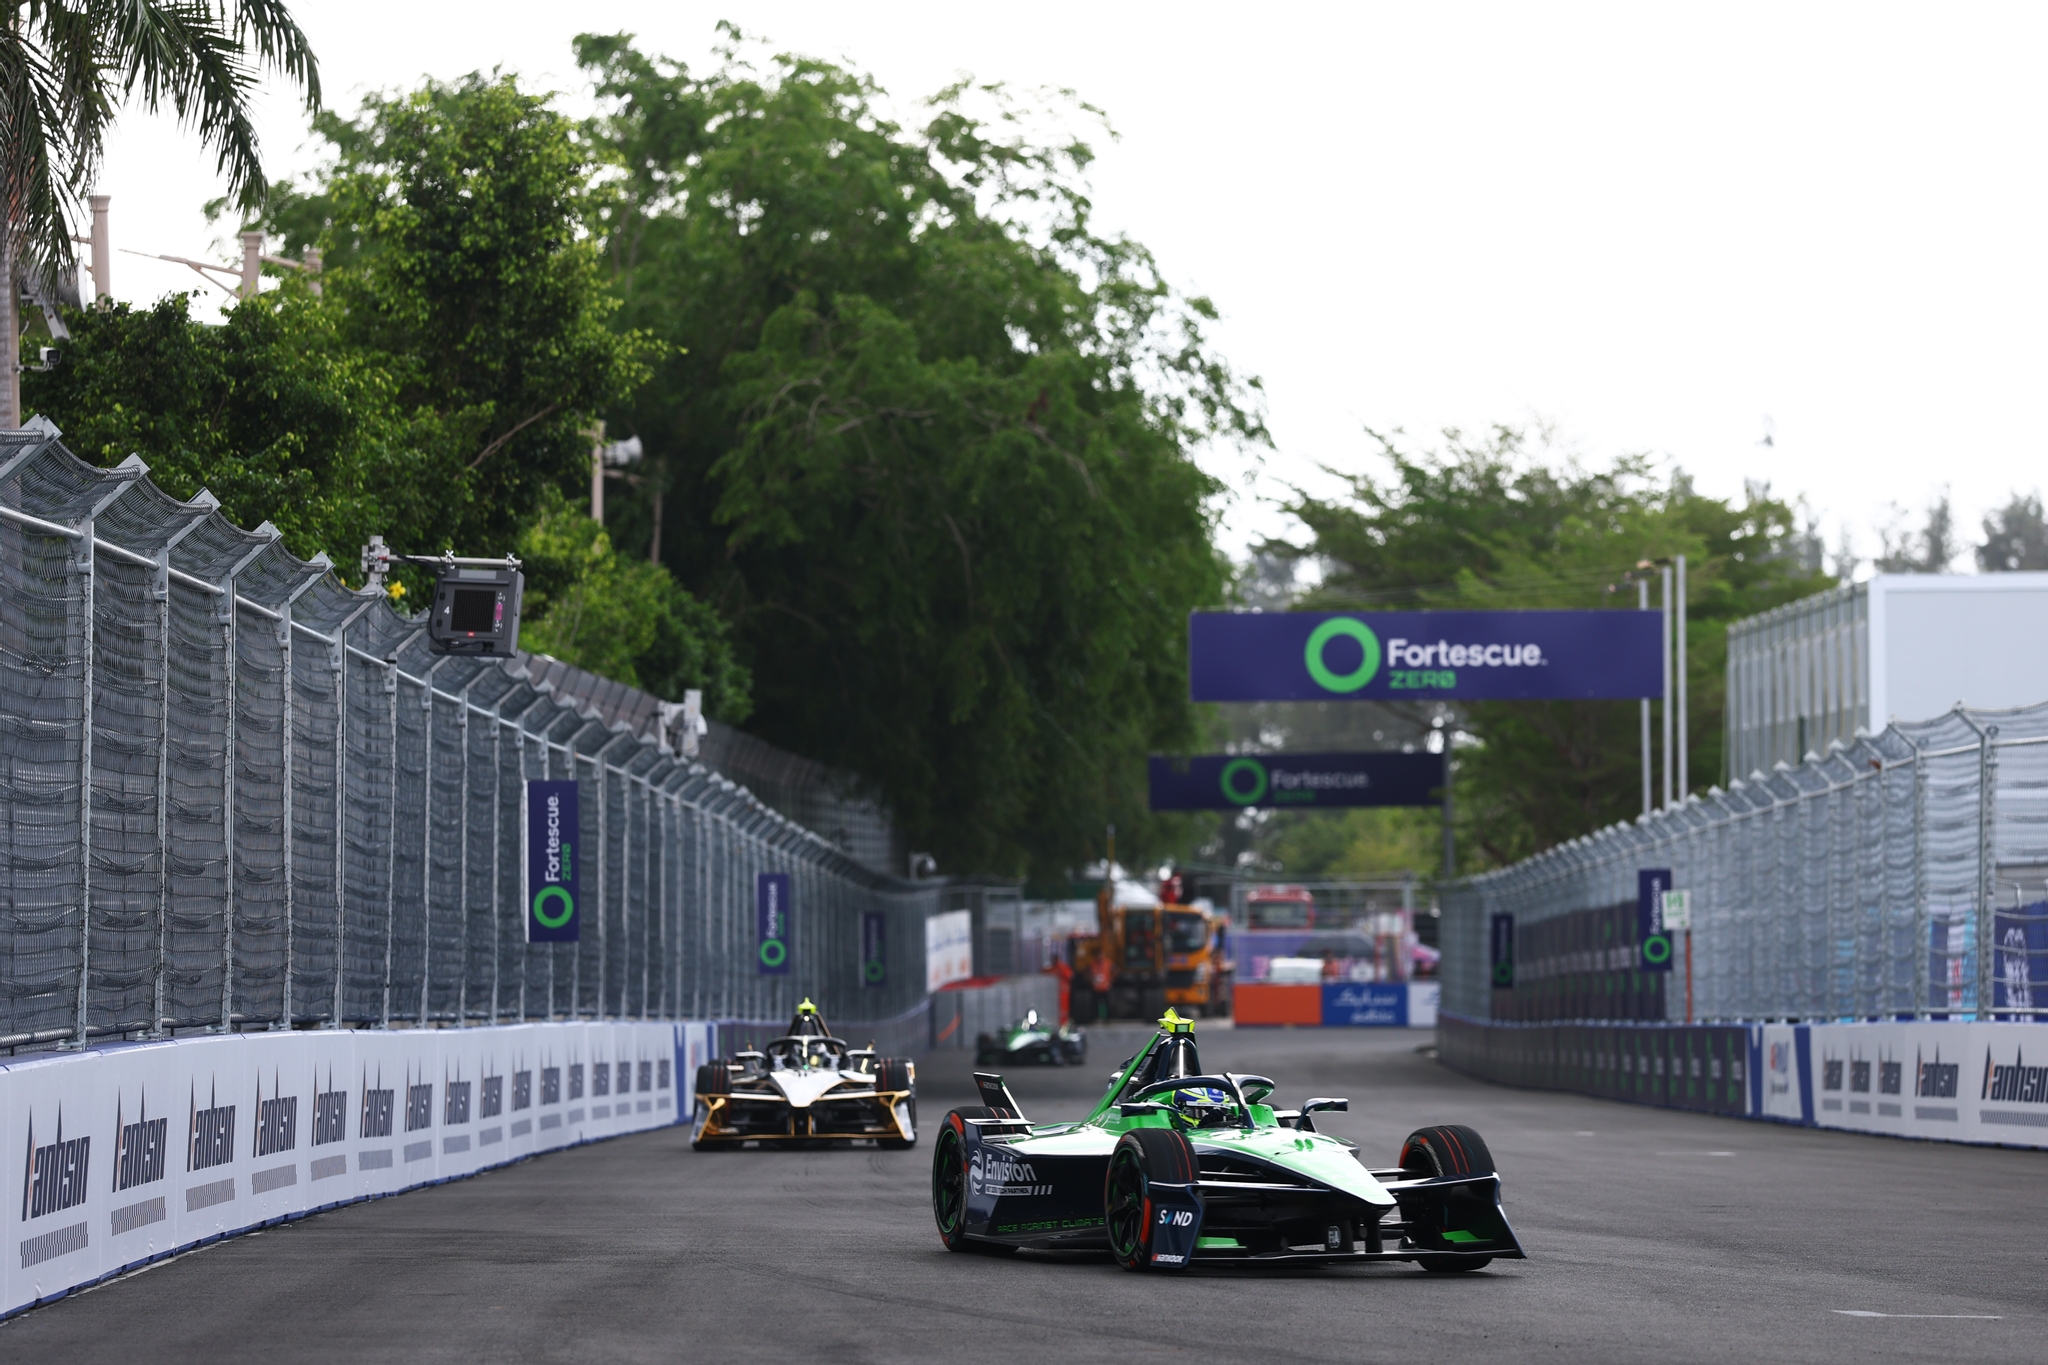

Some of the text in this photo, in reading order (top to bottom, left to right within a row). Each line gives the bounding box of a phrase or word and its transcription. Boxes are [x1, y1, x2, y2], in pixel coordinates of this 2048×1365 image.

[1387, 638, 1542, 667] Fortescue
[545, 796, 560, 882] Fortescue
[986, 1154, 1037, 1182] Envision
